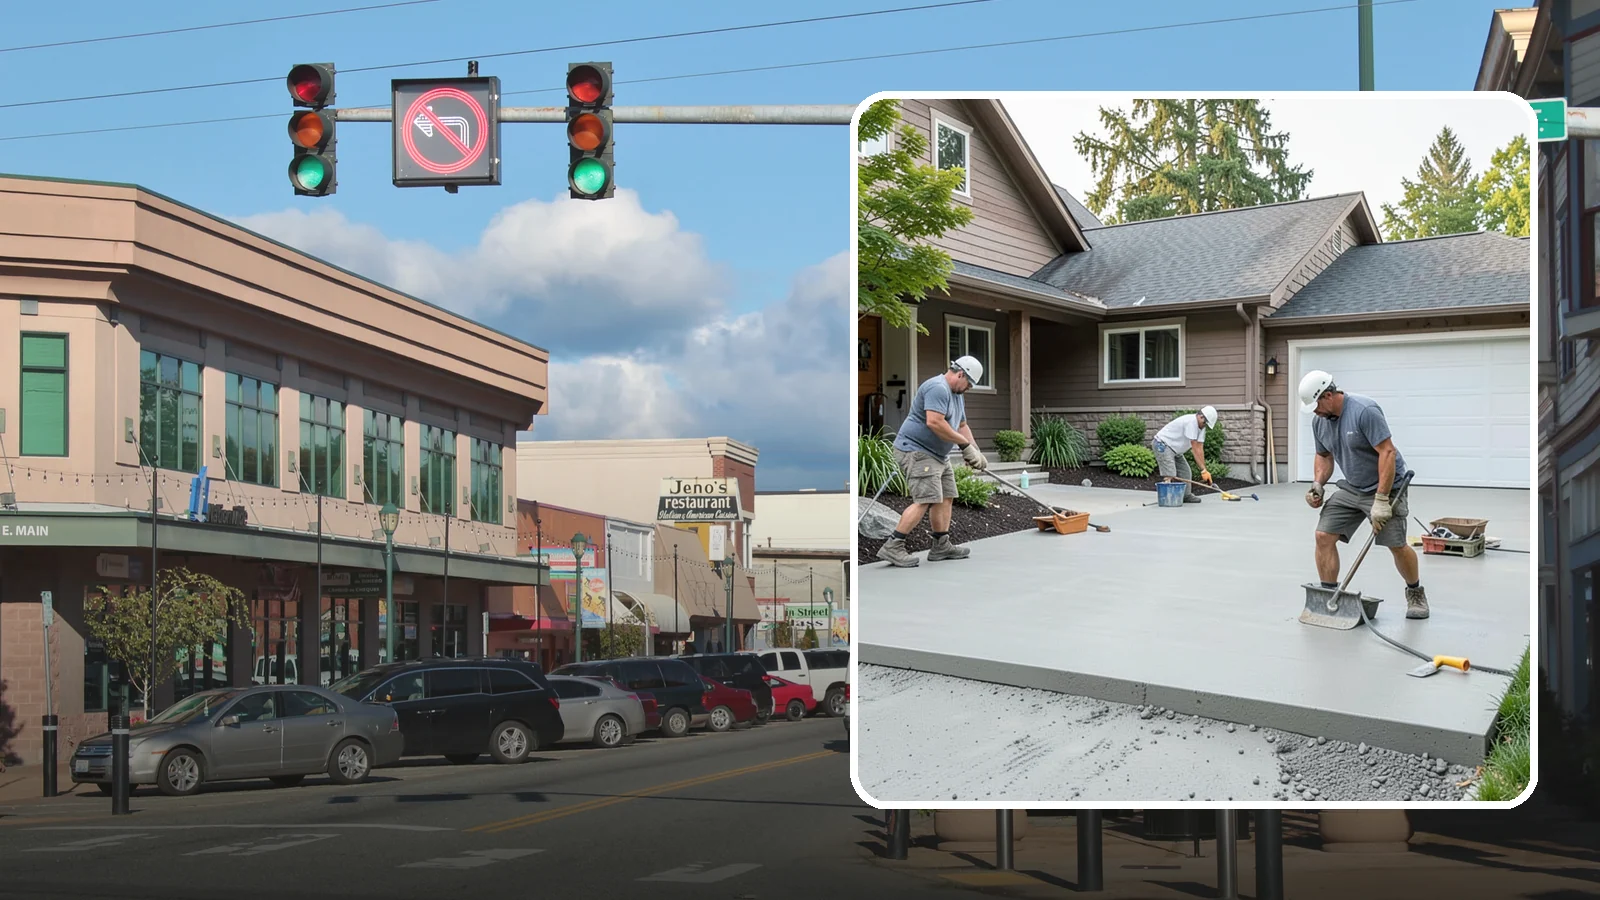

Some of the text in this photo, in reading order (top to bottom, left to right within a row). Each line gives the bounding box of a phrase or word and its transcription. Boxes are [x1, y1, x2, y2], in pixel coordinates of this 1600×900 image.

[670, 480, 727, 494] Jeno's
[665, 496, 731, 509] restaurant
[658, 510, 681, 519] Italian
[686, 509, 714, 519] American
[715, 509, 737, 519] Cuisine
[2, 525, 49, 536] E. MAIN
[797, 607, 828, 616] Street
